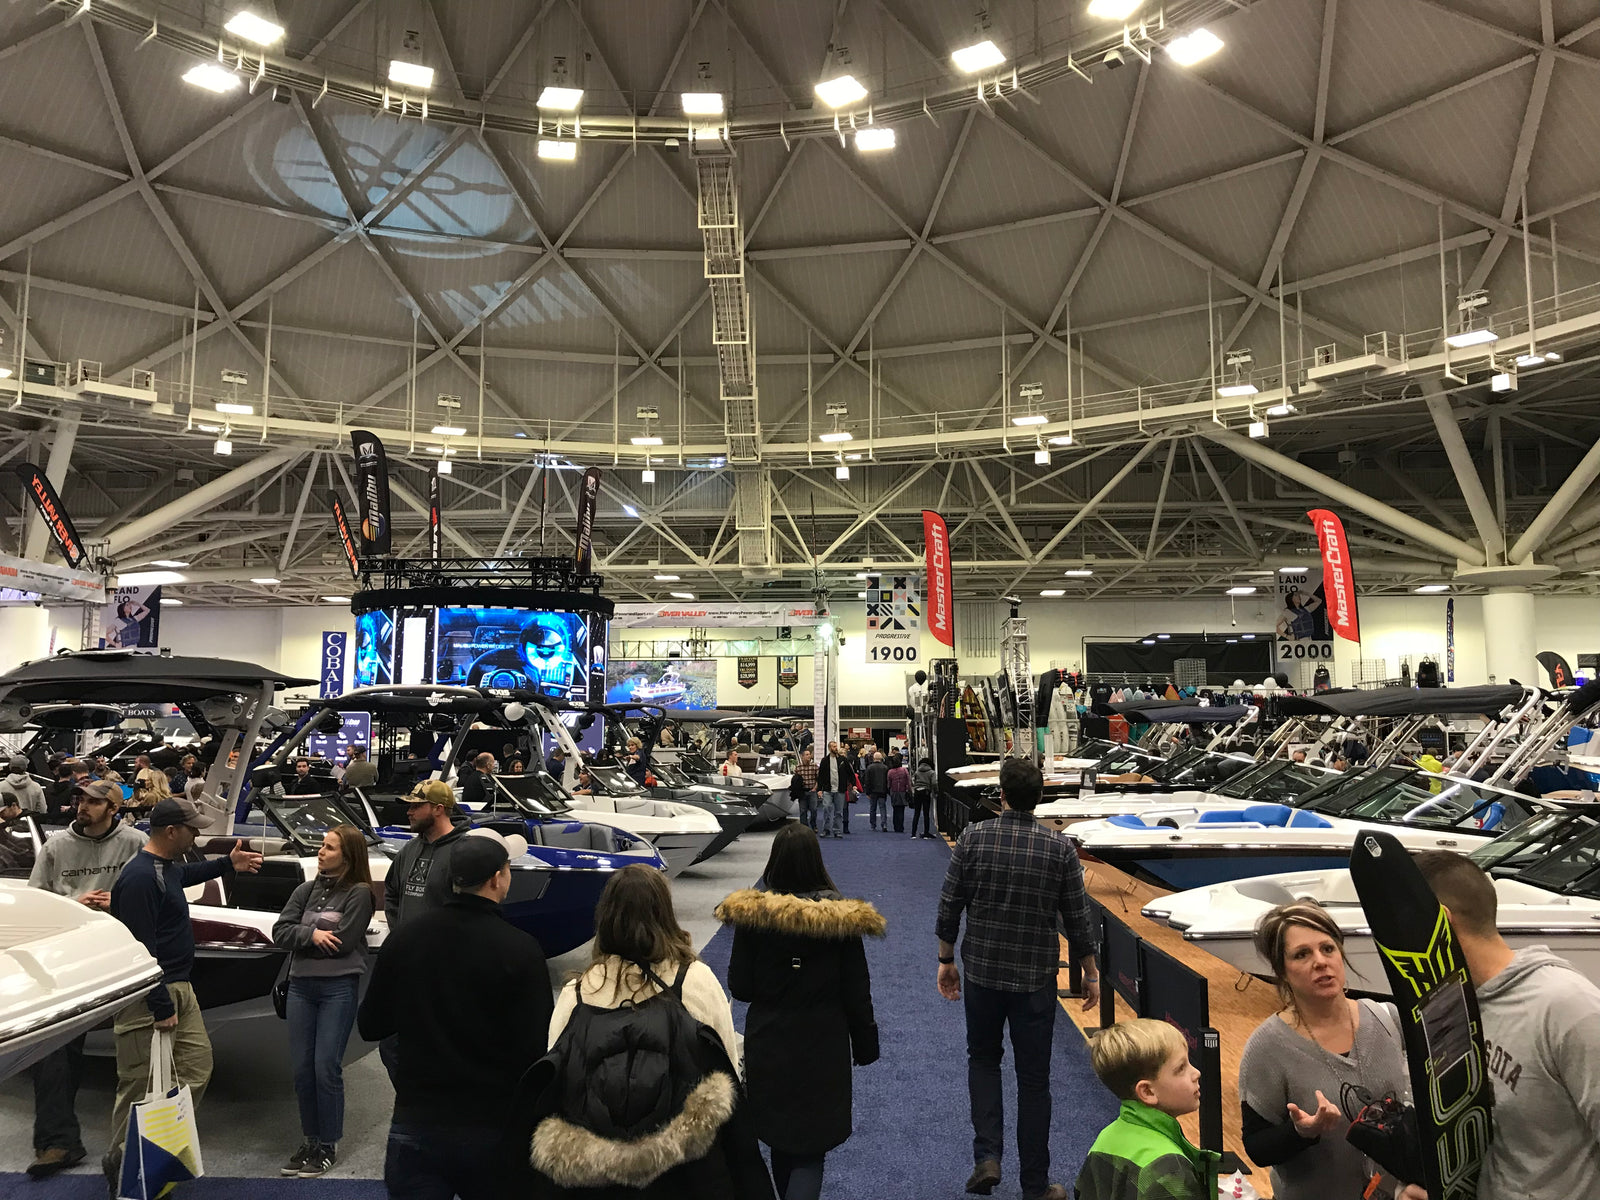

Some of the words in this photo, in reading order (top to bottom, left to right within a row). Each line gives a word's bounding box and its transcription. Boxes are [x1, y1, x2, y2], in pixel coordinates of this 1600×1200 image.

[932, 522, 946, 630] MasterCraft
[1279, 576, 1307, 584] LAND
[1322, 520, 1350, 626] MasterCraft
[1280, 586, 1298, 594] FLO
[870, 646, 917, 661] 1900
[1280, 644, 1332, 659] 2000
[62, 865, 118, 878] carhartt
[1484, 1039, 1523, 1095] SOTA
